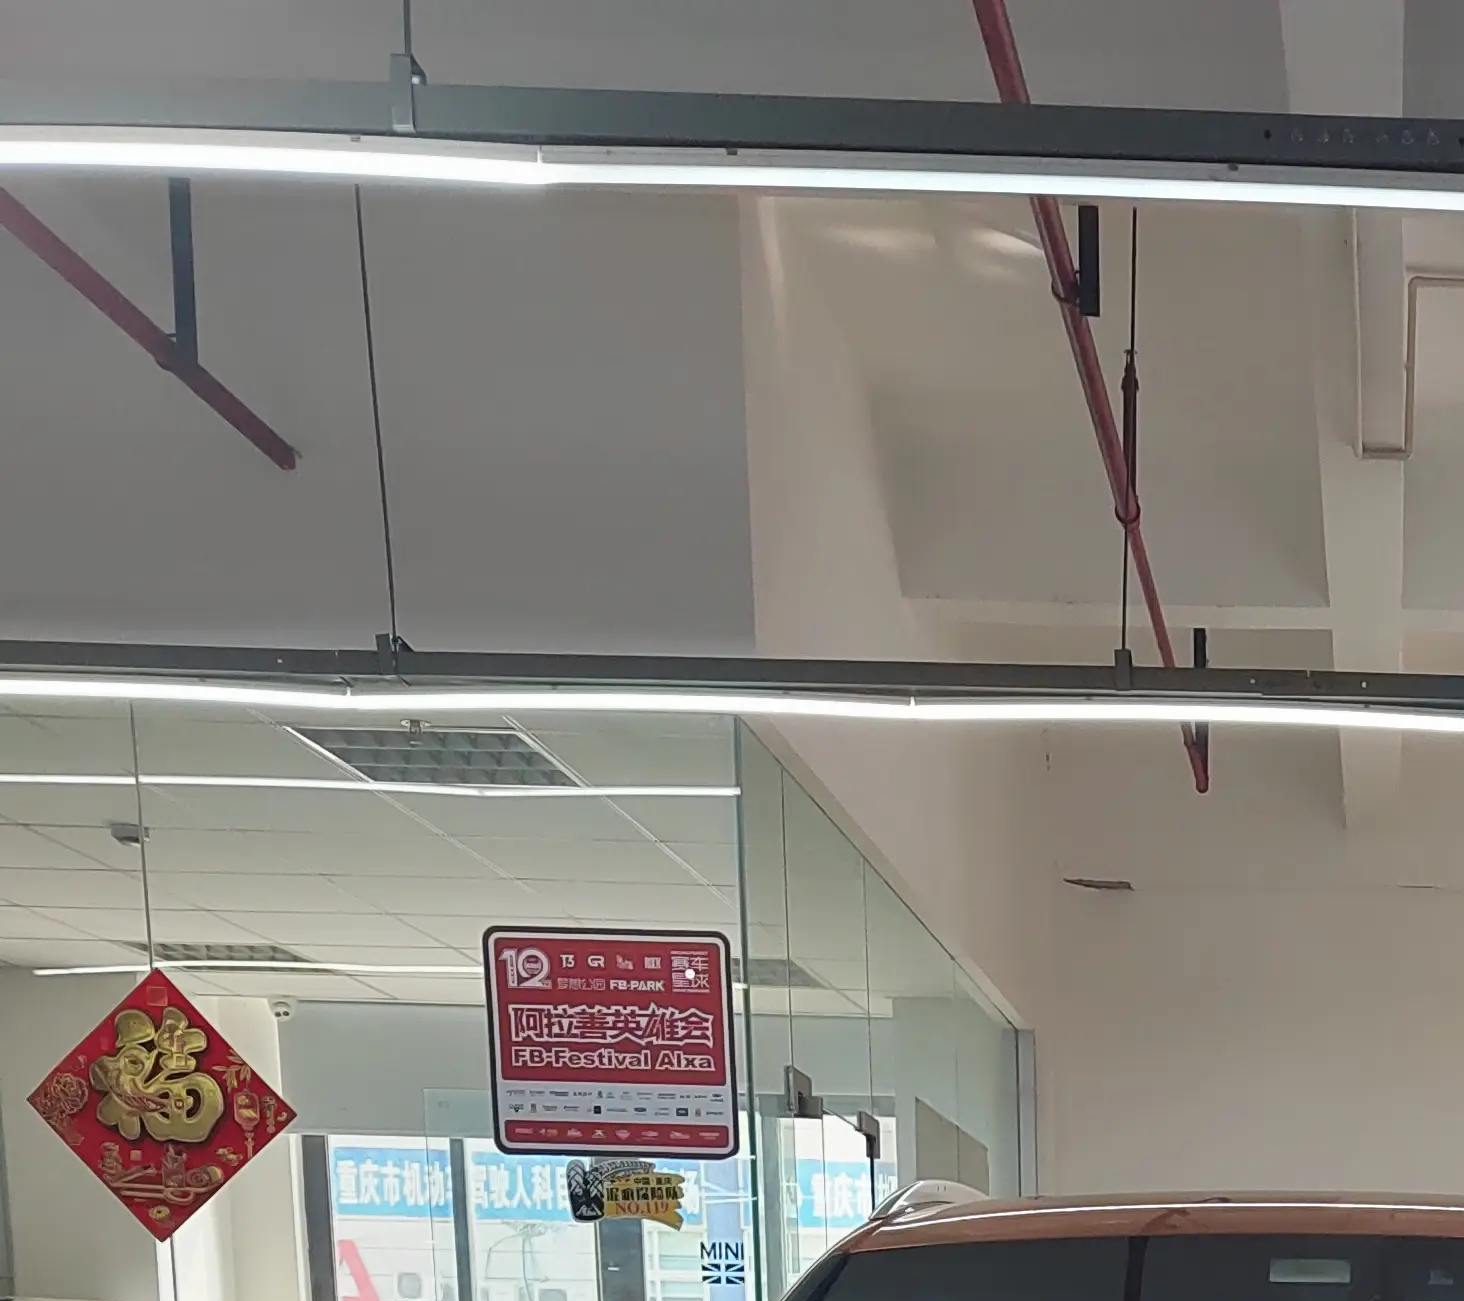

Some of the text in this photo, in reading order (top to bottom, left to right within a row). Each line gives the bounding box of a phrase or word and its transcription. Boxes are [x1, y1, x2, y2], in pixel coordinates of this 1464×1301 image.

[508, 1001, 714, 1048] 阿拉善英雄会
[511, 1046, 716, 1072] FB-Festival Alxa
[615, 1202, 669, 1214] NO.119
[700, 1242, 744, 1261] MINI
